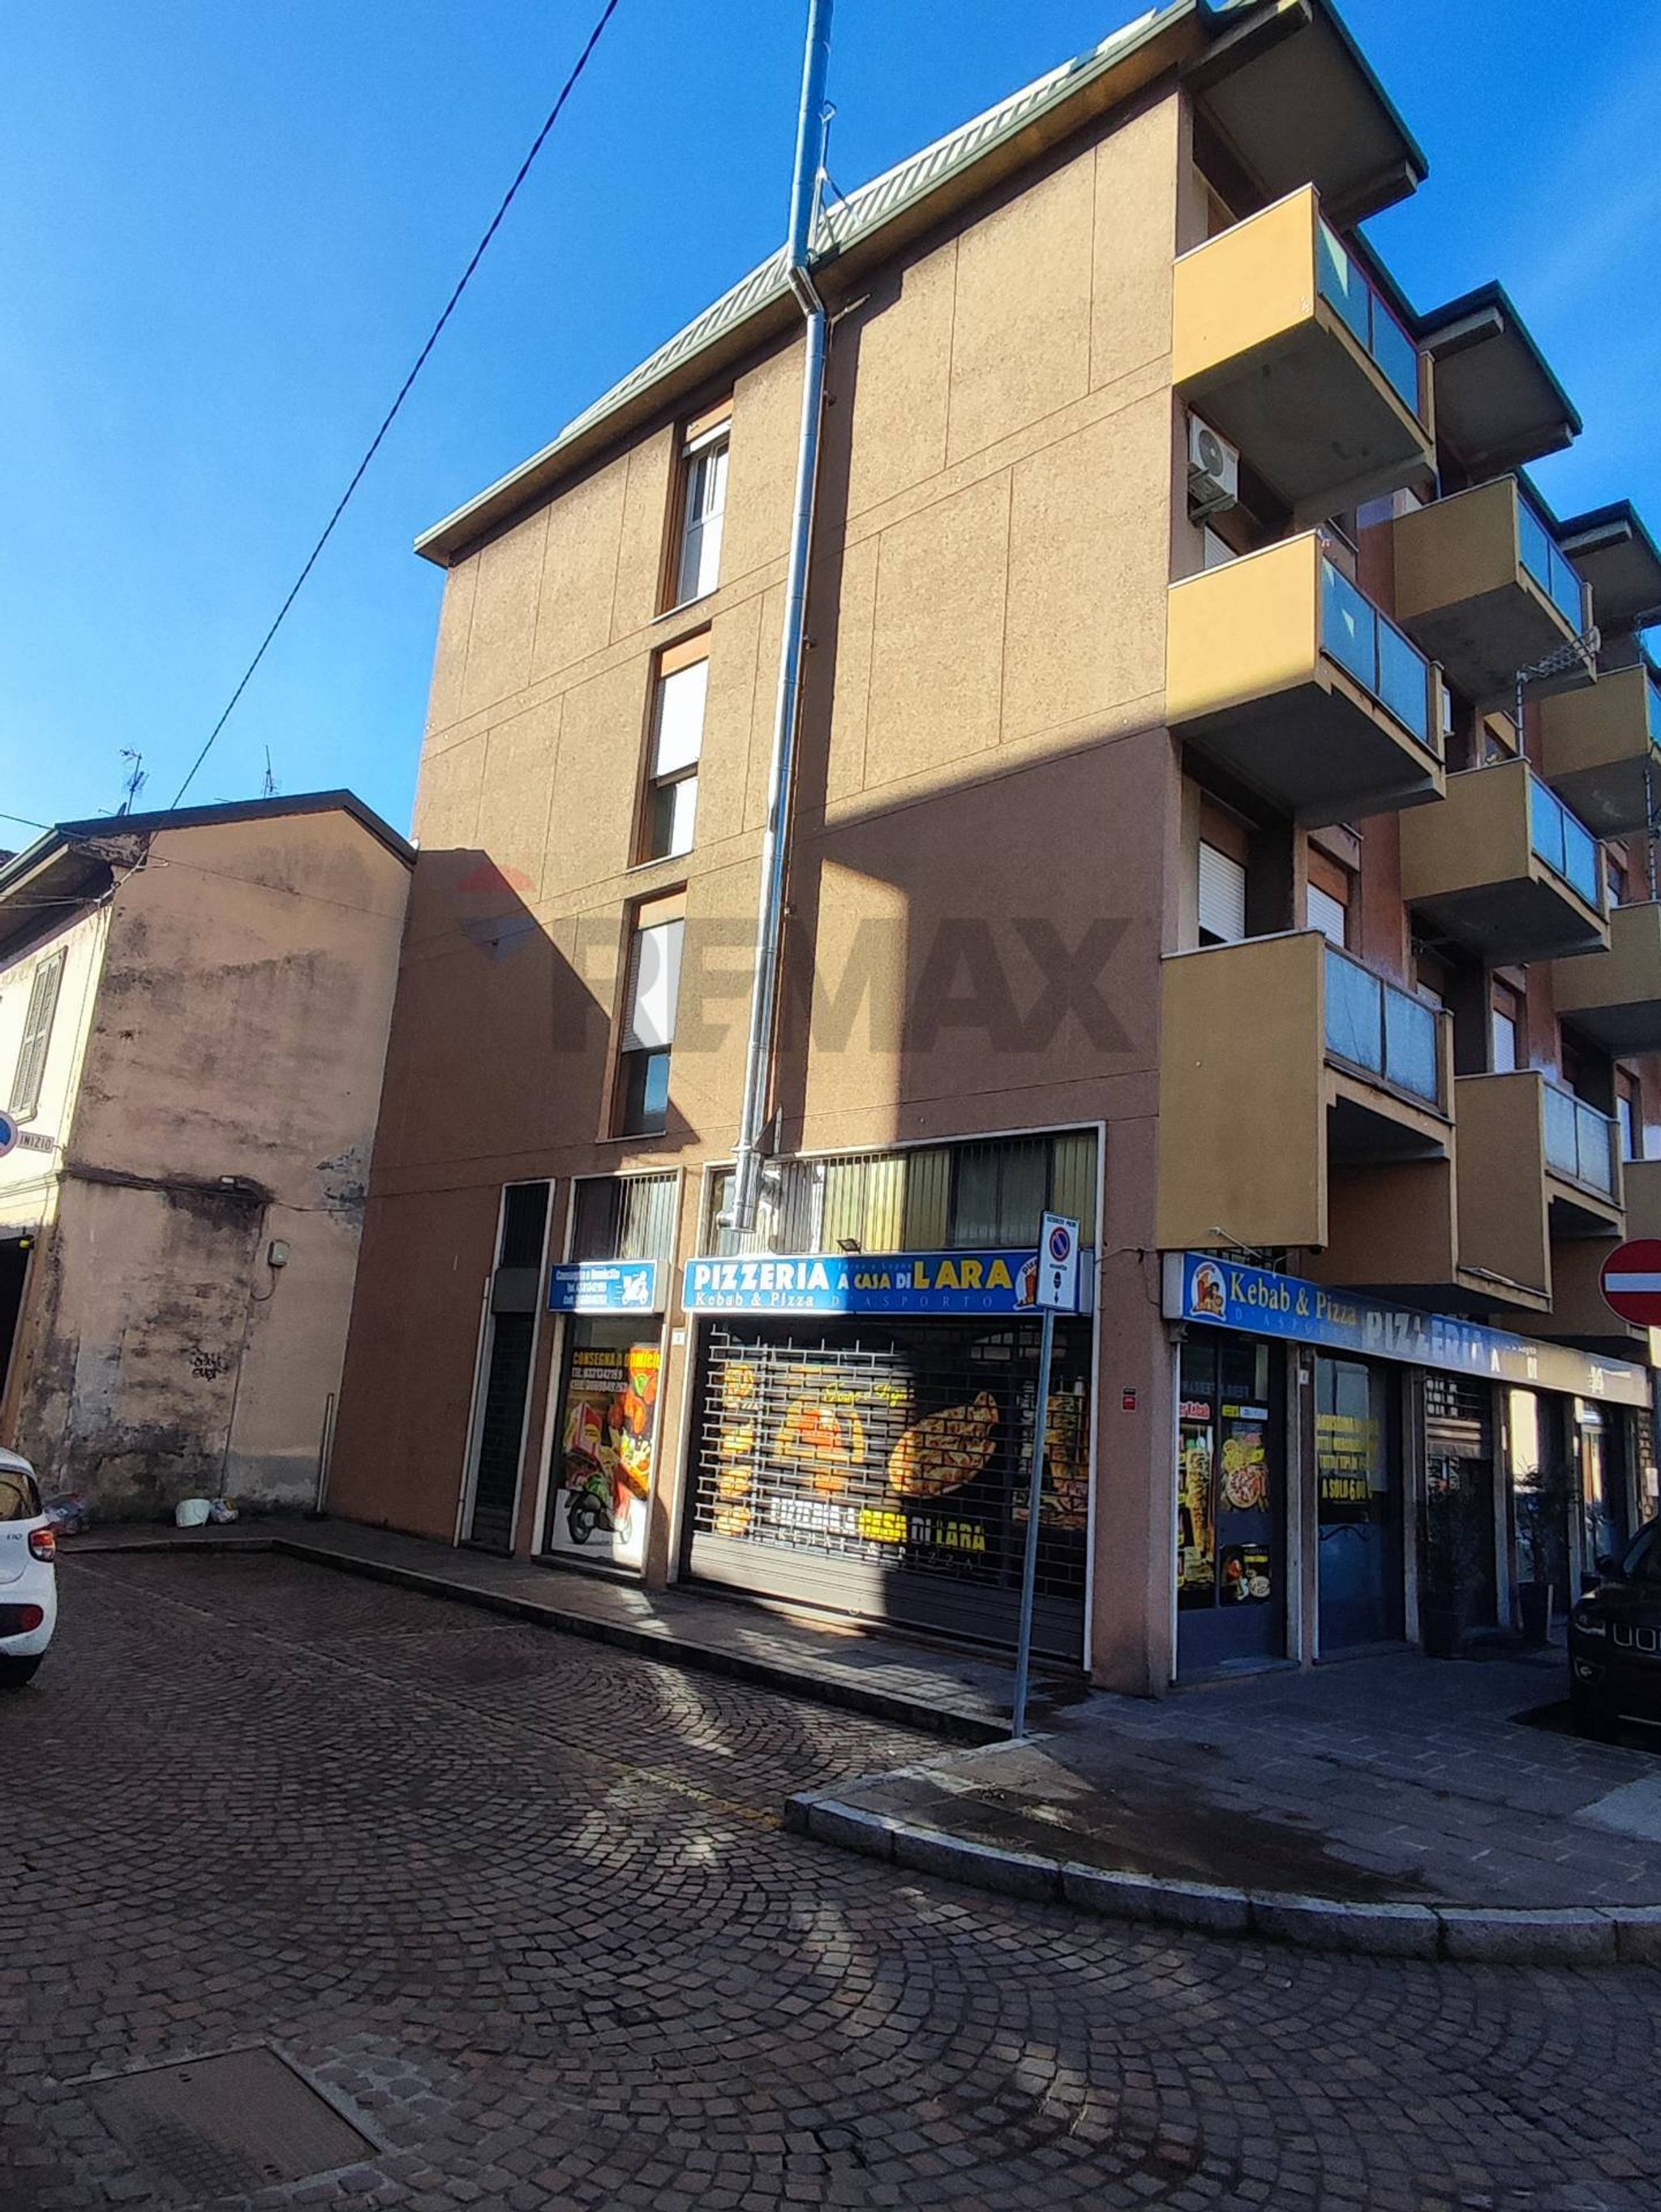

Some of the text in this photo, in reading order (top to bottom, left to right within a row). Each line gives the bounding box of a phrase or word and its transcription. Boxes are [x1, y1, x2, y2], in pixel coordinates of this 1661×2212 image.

[19, 1134, 52, 1150] INIZIO
[693, 1262, 830, 1291] PIZZERIA
[837, 1273, 849, 1291] A
[854, 1273, 891, 1290] CASA
[895, 1272, 912, 1290] DI
[913, 1260, 1013, 1289] LARA
[695, 1291, 814, 1307] Kebab & Pizza
[1230, 1271, 1290, 1312] Kebab
[1296, 1287, 1310, 1316] &
[1316, 1291, 1357, 1325] Pizza
[1363, 1311, 1488, 1365] PIZZERIA
[859, 1508, 908, 1543] CASA
[911, 1515, 932, 1544] DI
[936, 1518, 986, 1553] LARA
